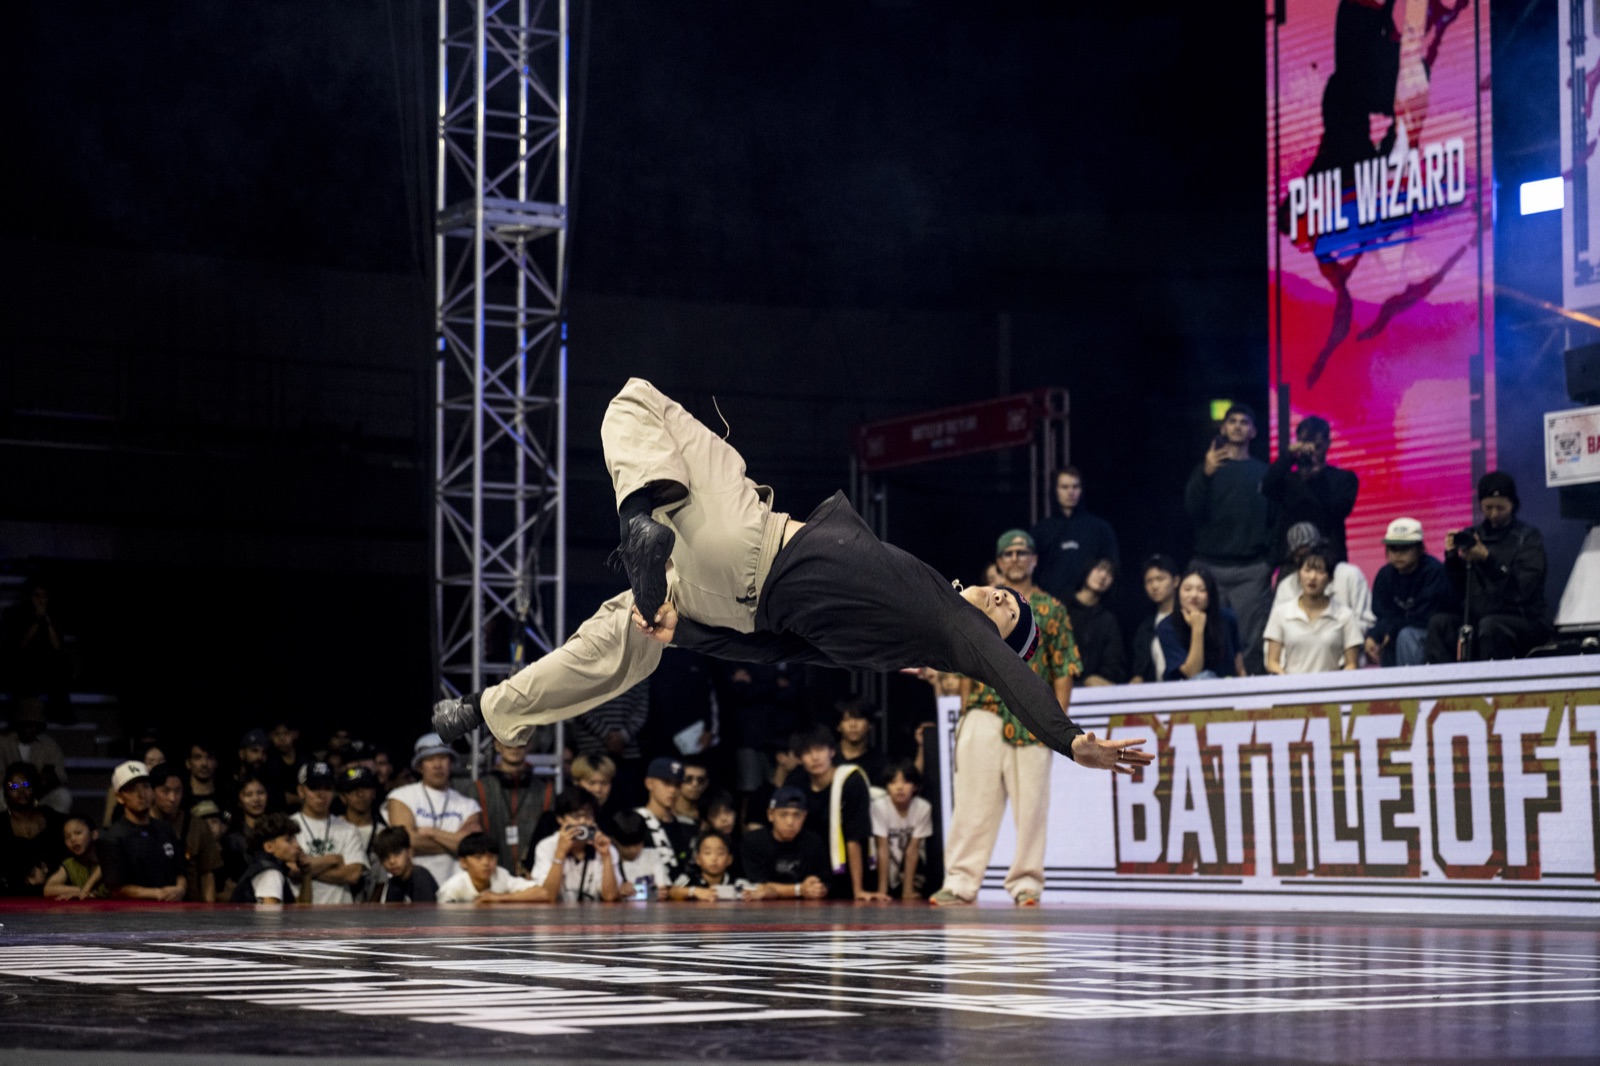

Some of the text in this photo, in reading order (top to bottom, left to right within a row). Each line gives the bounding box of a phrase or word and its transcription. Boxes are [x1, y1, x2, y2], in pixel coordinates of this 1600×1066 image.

[1288, 137, 1466, 242] PHIL WIZARD
[1109, 712, 1408, 866] BATTLE
[1431, 706, 1551, 867] OF
